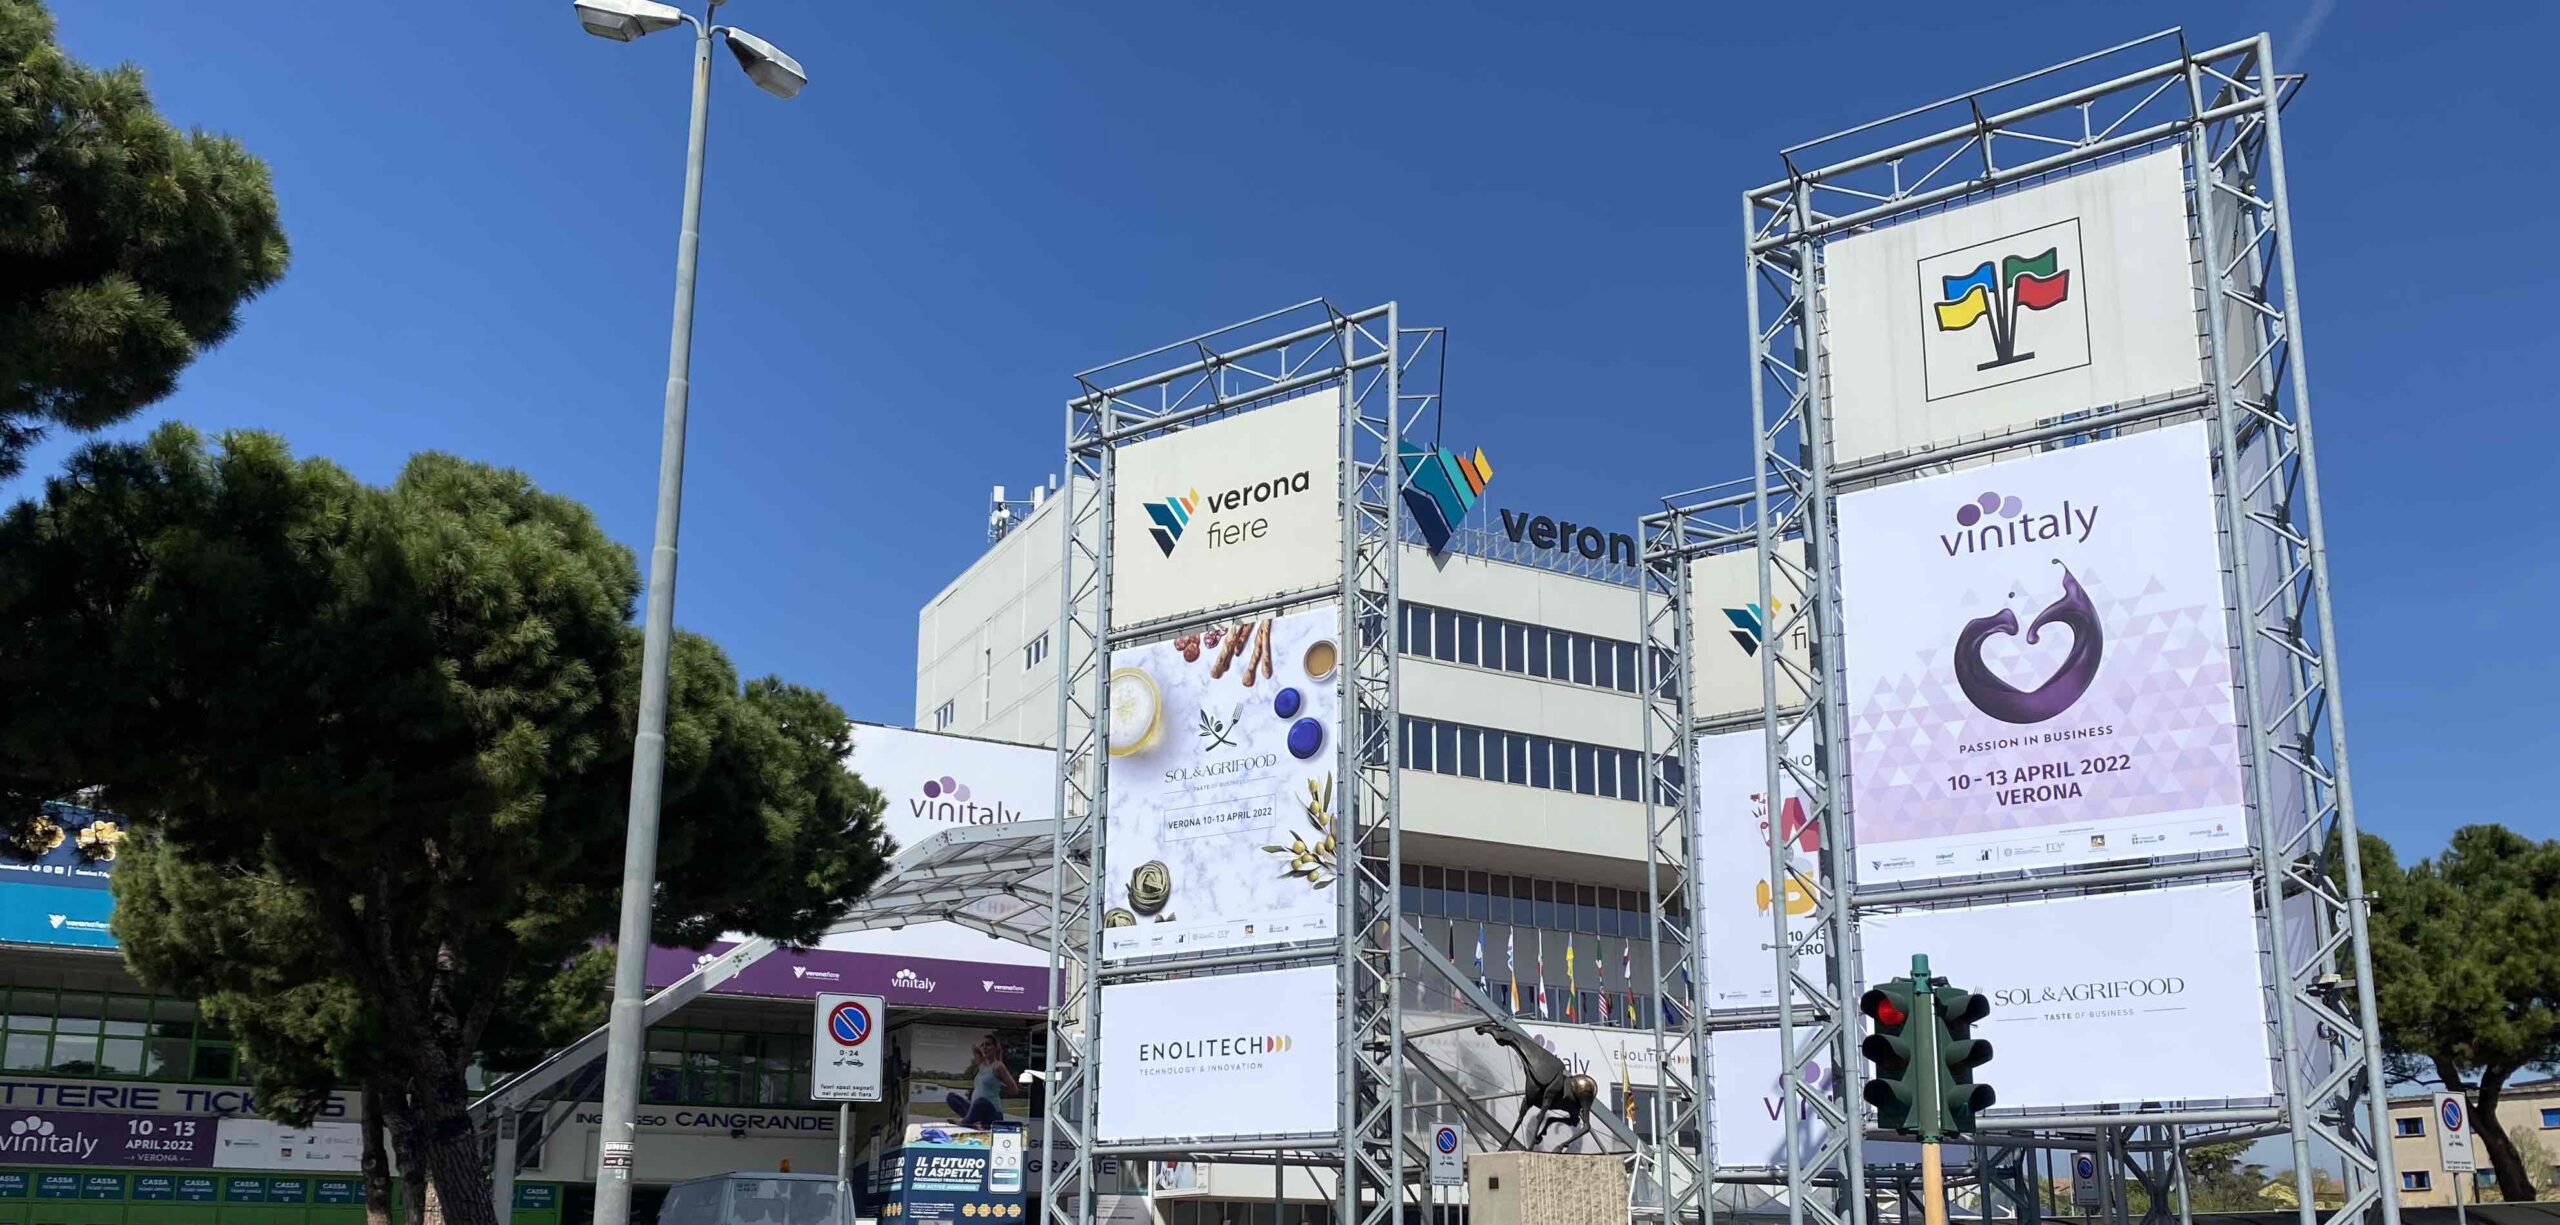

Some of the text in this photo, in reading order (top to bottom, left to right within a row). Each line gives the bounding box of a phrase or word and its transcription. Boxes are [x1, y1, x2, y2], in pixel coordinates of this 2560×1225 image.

[1207, 471, 1310, 514] verona
[1207, 518, 1268, 550] fiere
[1500, 508, 1636, 567] veron
[1940, 500, 2099, 557] vinitaly
[1959, 725, 2114, 754] PASSION IN BUSINESS
[1165, 753, 1277, 784] SOL&AGRIFOOD
[1948, 774, 1971, 791] 10
[1985, 769, 2009, 787] 13
[2013, 761, 2075, 784] APRIL
[2080, 754, 2132, 776] 2022
[1996, 782, 2083, 806] VERONA
[909, 798, 1021, 826] vinitaly
[1168, 806, 1273, 830] VERONA 10-13 APRIL 2022
[891, 977, 936, 993] vinitaly
[1994, 977, 2185, 1007] SOL&AGRIFOOD
[2044, 1009, 2134, 1021] TASTE OF BUSINESS
[1140, 1036, 1263, 1062] ENOLITECH
[1140, 1066, 1197, 1076] TECHNOLOGY
[1207, 1062, 1263, 1072] INNOVATION
[128, 1119, 153, 1135] 10
[173, 1121, 196, 1136] 13
[675, 1111, 835, 1130] CANGRANDE
[0, 1131, 98, 1159] vinitaly
[125, 1139, 193, 1151] APRIL 2022
[137, 1153, 178, 1162] VERONA
[914, 1167, 983, 1179] CI ASPETTA.
[916, 1156, 928, 1167] IL
[931, 1157, 986, 1169] FUTURO
